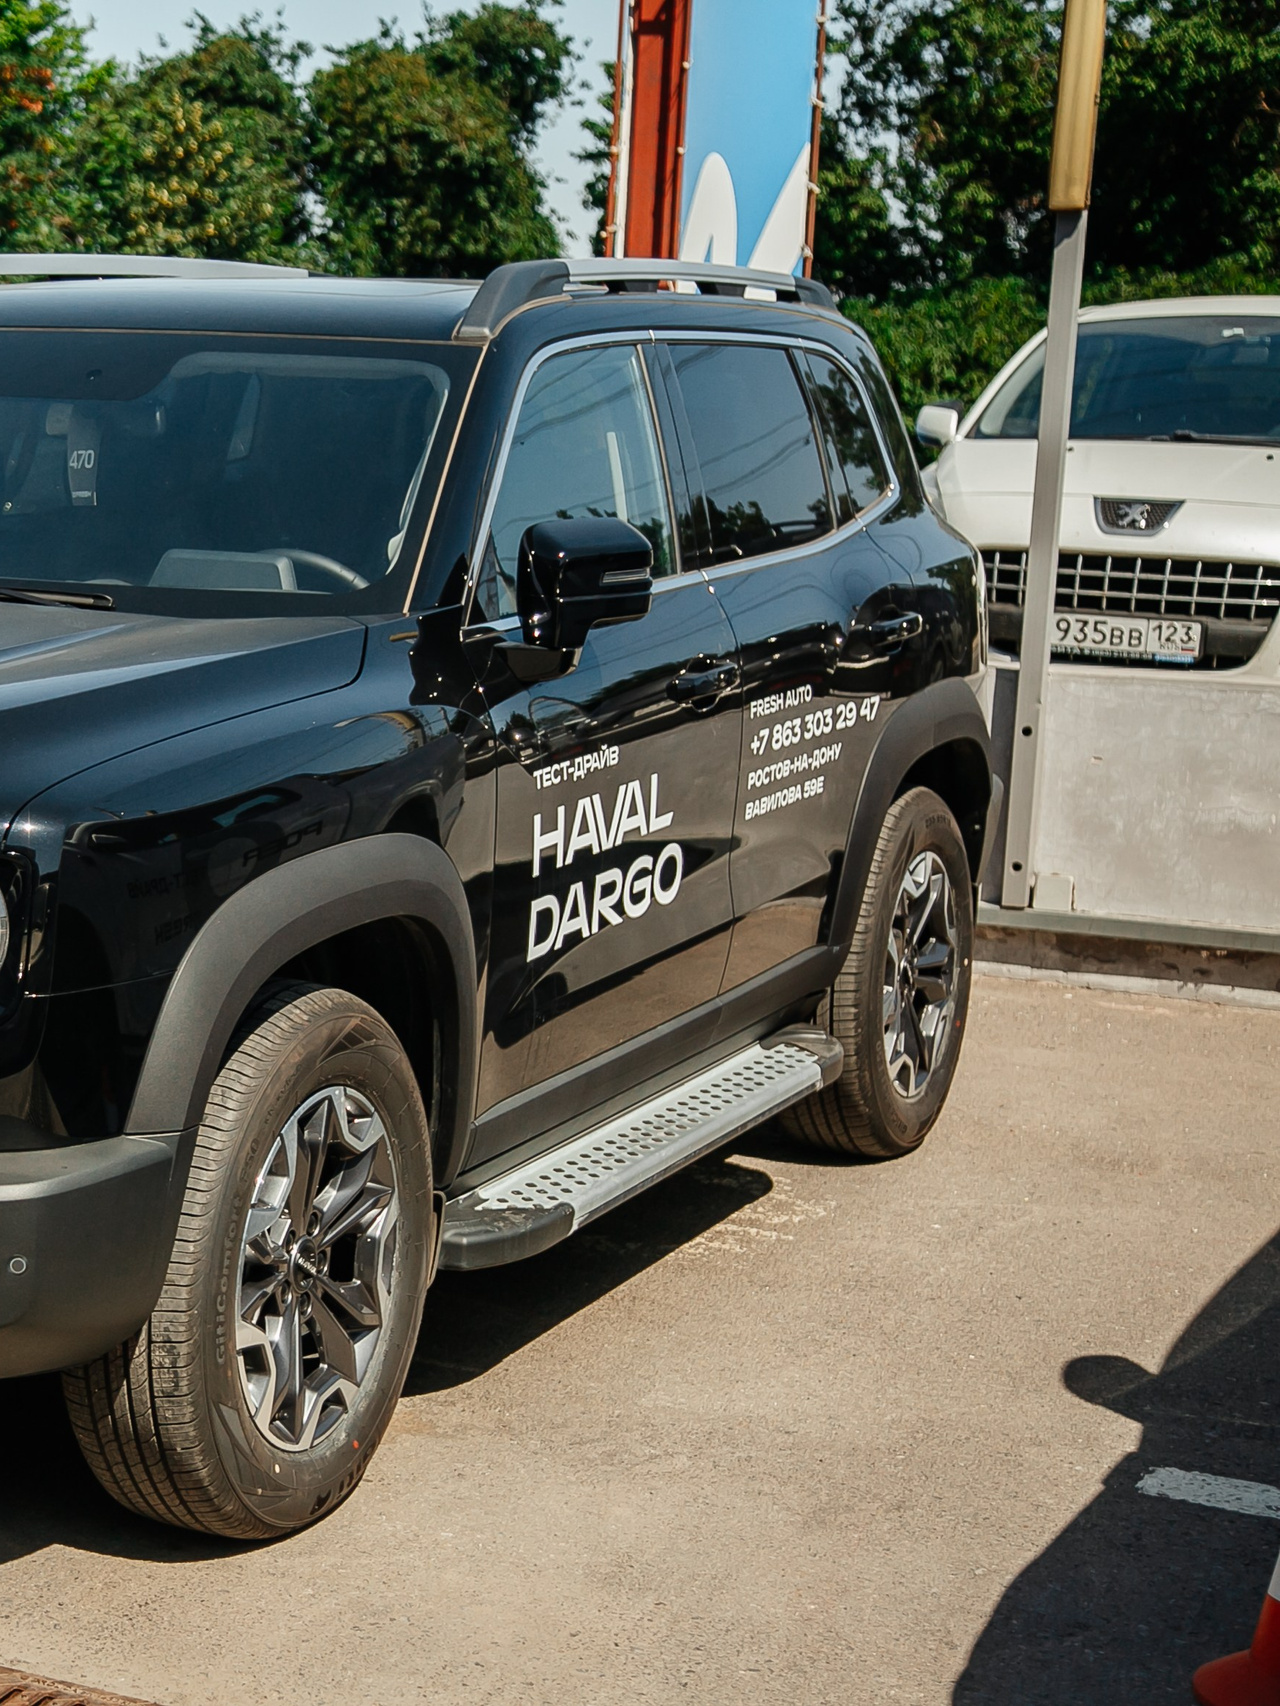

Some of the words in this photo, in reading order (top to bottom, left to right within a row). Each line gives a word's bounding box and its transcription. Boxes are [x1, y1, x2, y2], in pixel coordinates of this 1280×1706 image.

[69, 449, 95, 469] 470
[1152, 621, 1193, 644] 123
[749, 692, 784, 719] FRESH
[785, 684, 813, 709] AUTO
[750, 727, 770, 756] +7
[771, 717, 802, 751] 863
[804, 707, 833, 740] 303
[835, 701, 857, 731] 29
[859, 695, 881, 722] 47
[532, 744, 620, 790] ТЕСТ-ДРАЙВ
[747, 742, 842, 790] РОСТОВ-НА-ДОНУ
[532, 773, 674, 878] HAVAL
[744, 784, 802, 821] ВАВИЛОВА
[527, 842, 683, 963] DARGO
